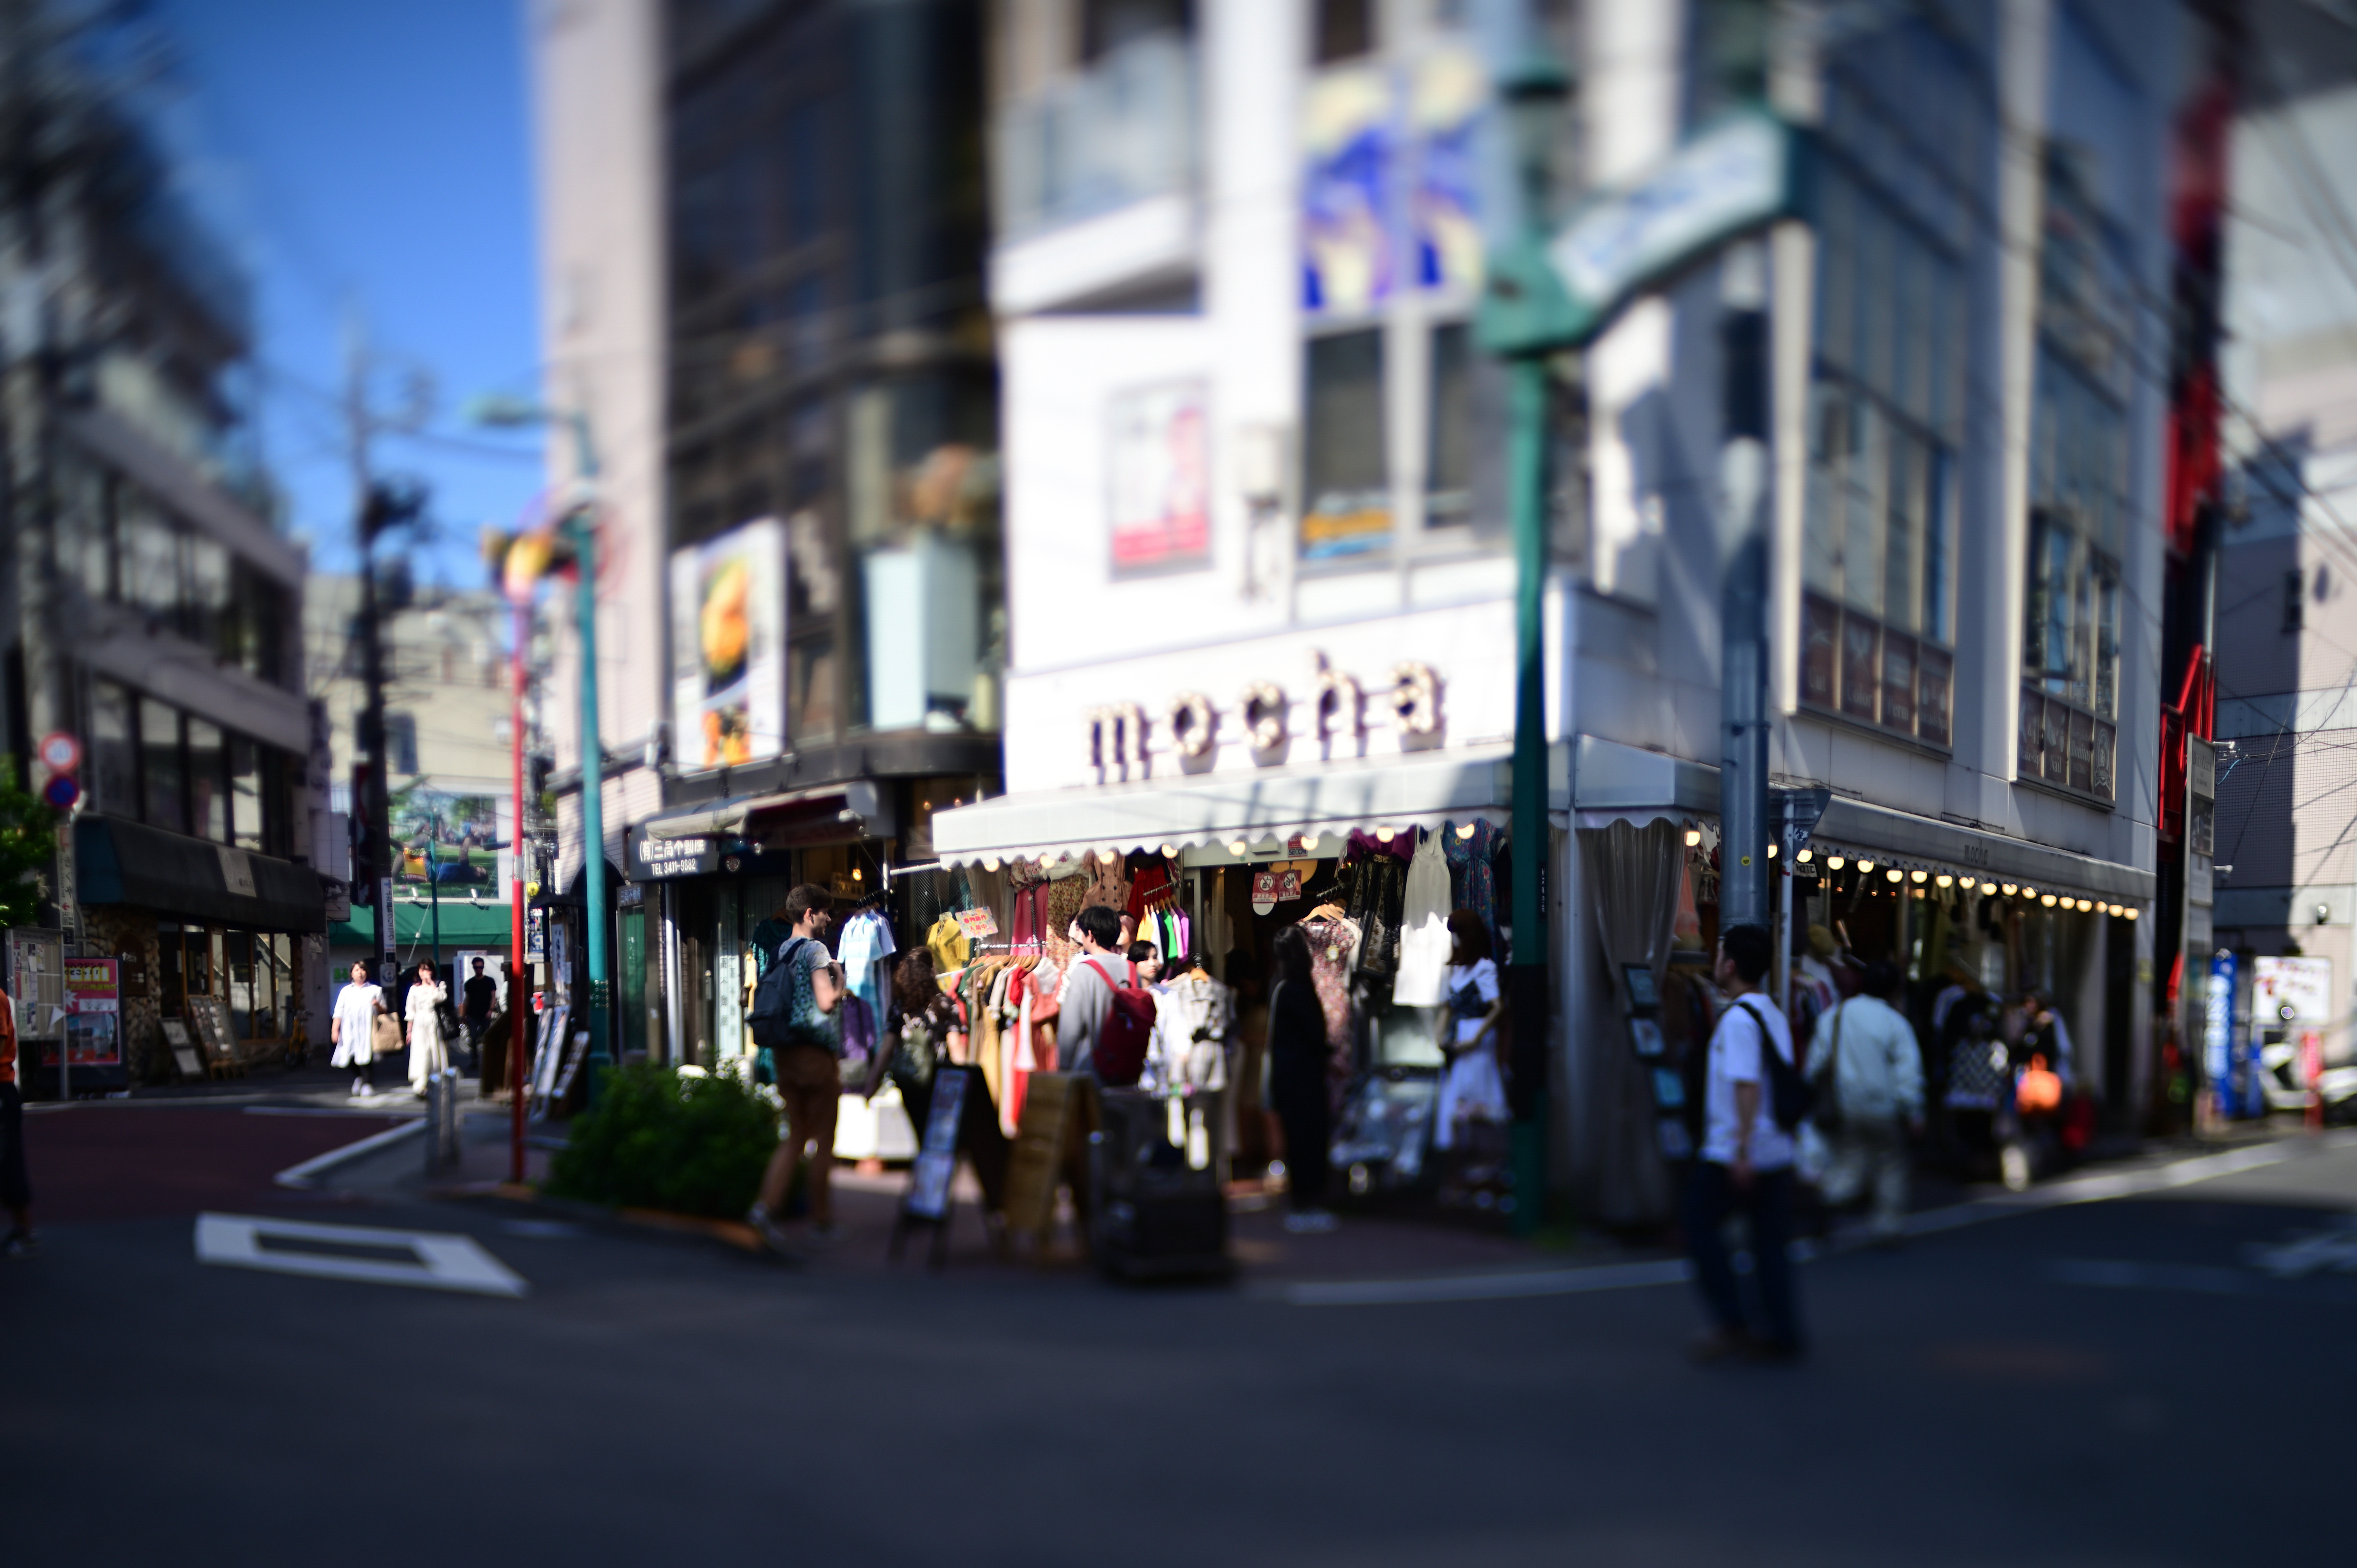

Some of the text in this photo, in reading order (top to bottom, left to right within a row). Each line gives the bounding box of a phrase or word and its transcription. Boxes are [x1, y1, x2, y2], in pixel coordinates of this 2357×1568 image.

[1083, 648, 1445, 766] mocha
[1888, 697, 1909, 721] Perm
[2020, 745, 2040, 770] Make-Up
[2071, 740, 2091, 762] Bonitas
[2050, 755, 2062, 773] Nail
[1965, 839, 1988, 865] mocha
[651, 858, 696, 875] TEL 3411-9882
